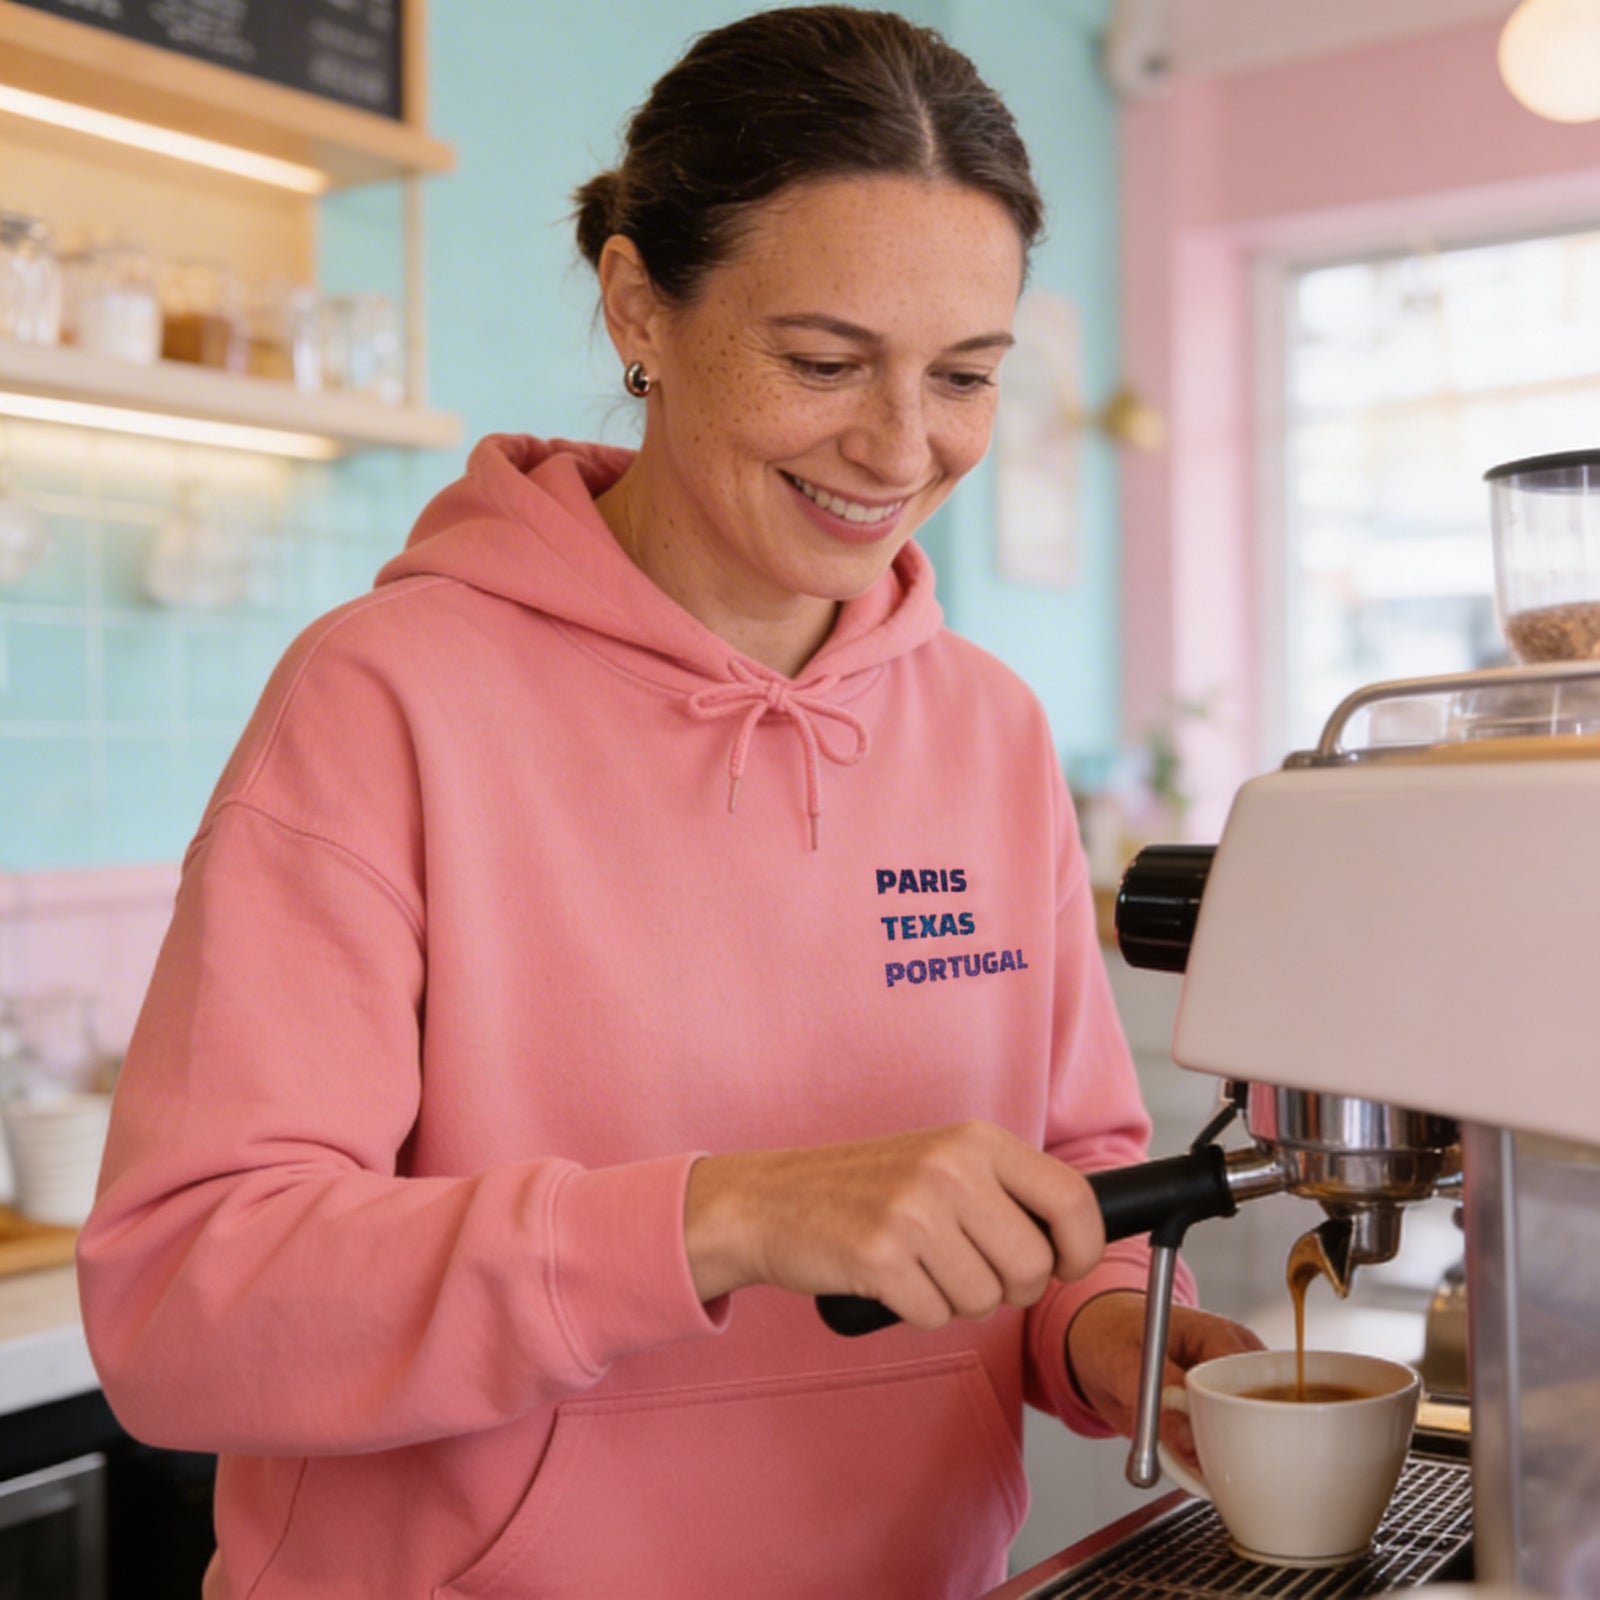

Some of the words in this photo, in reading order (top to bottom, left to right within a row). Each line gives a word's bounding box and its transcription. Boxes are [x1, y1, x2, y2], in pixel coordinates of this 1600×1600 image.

[876, 869, 967, 894] PARIS
[881, 912, 975, 940] TEXAS
[885, 949, 1028, 987] PORTUGAL
